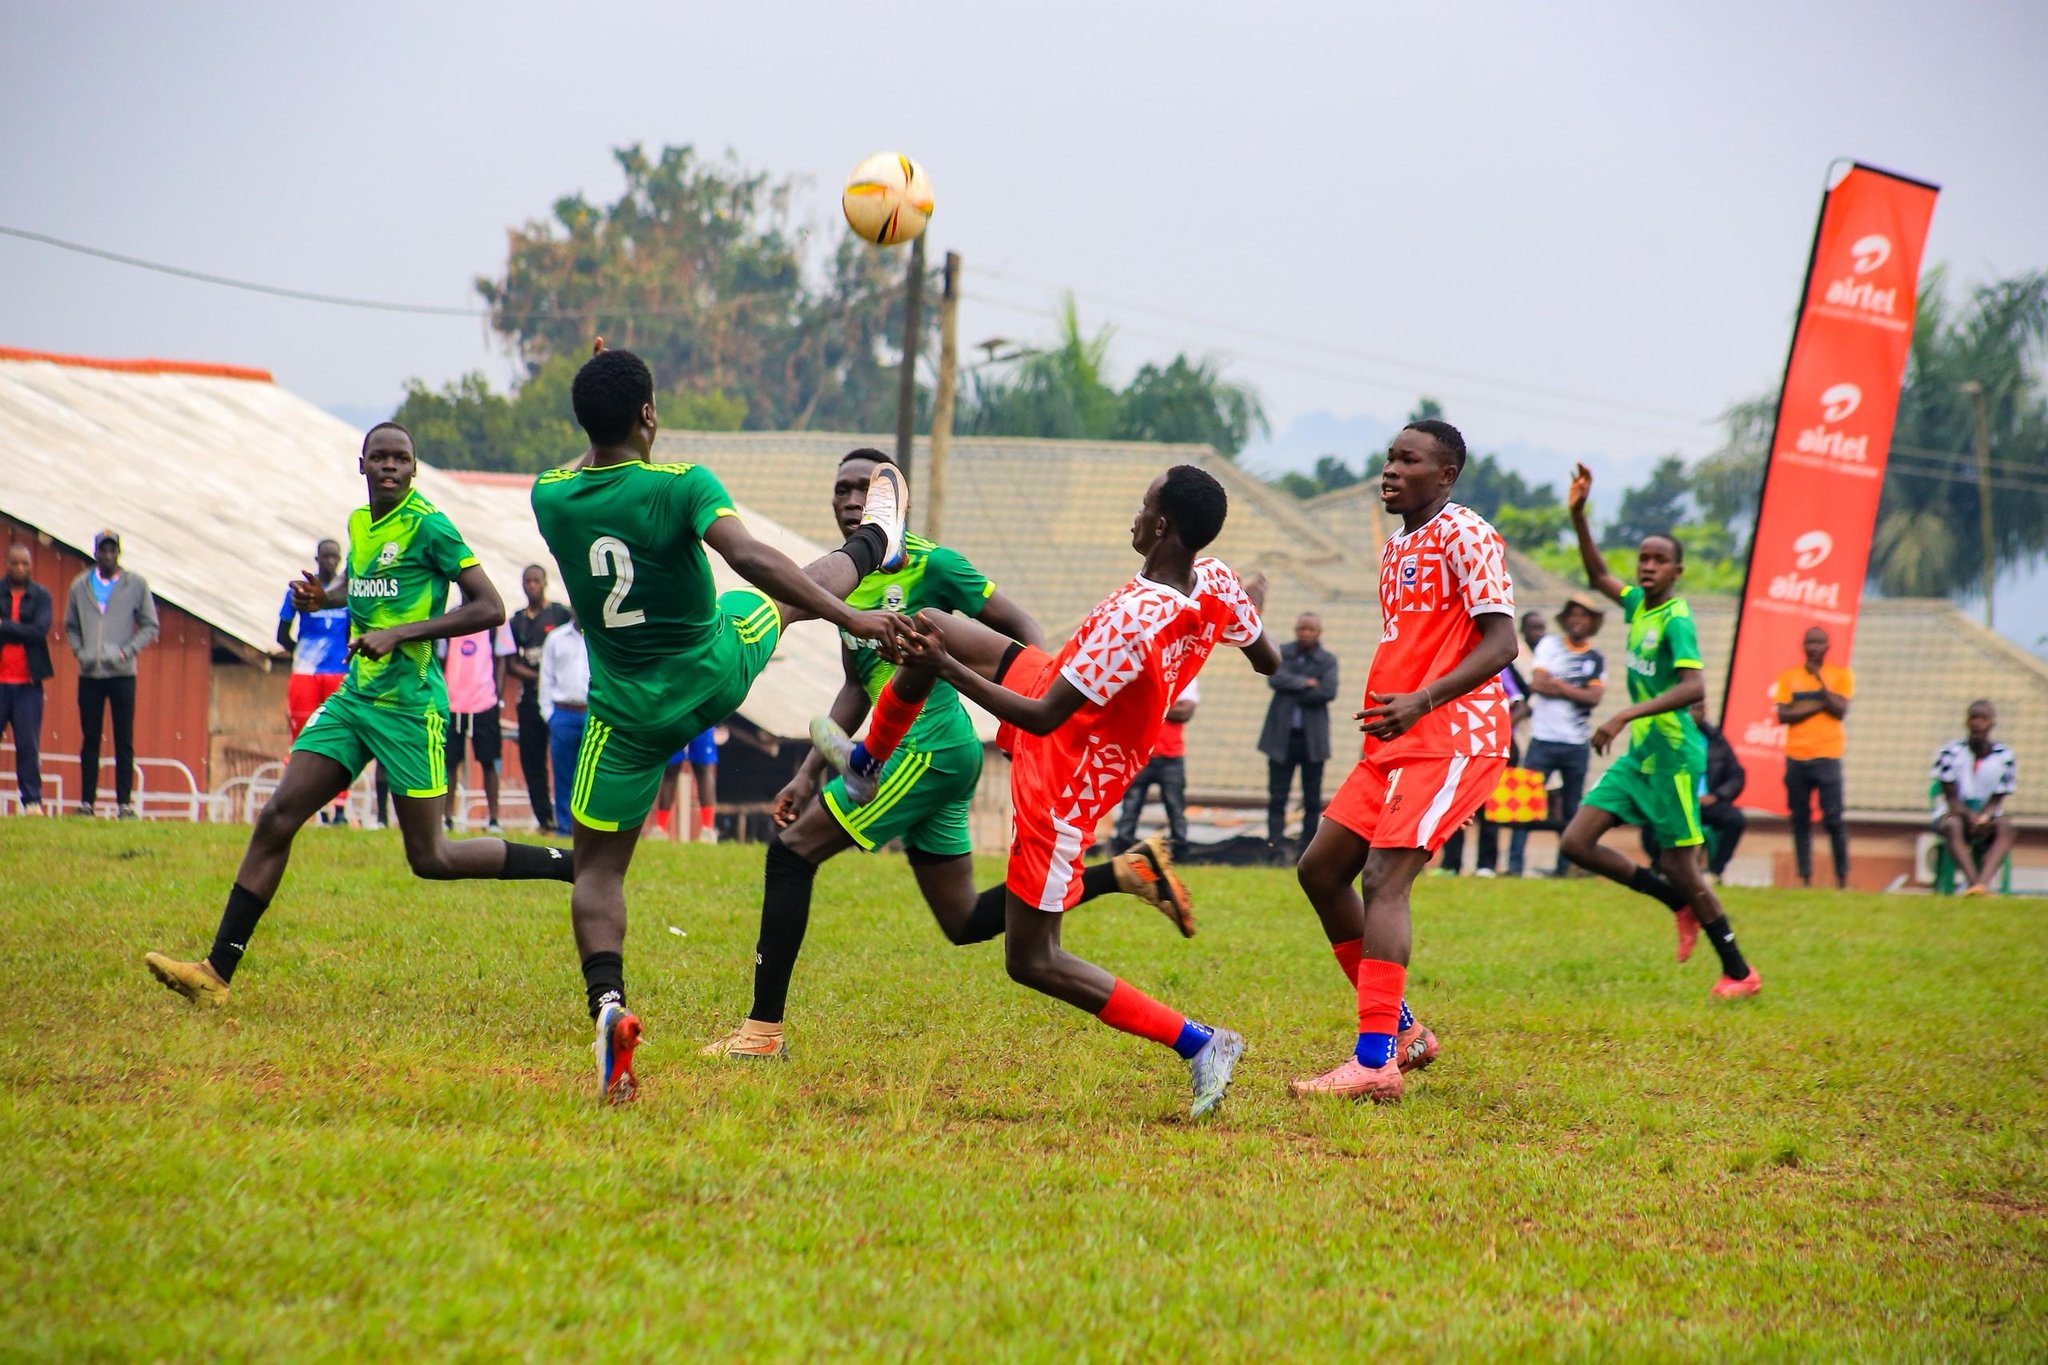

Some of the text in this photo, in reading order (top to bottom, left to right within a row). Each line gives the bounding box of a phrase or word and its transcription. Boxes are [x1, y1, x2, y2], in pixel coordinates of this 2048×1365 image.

[1825, 277, 1896, 315] airtel
[1796, 425, 1868, 463] airtel
[353, 578, 399, 597] SCHOOLS
[589, 535, 646, 629] 2
[1768, 571, 1839, 609] airtel
